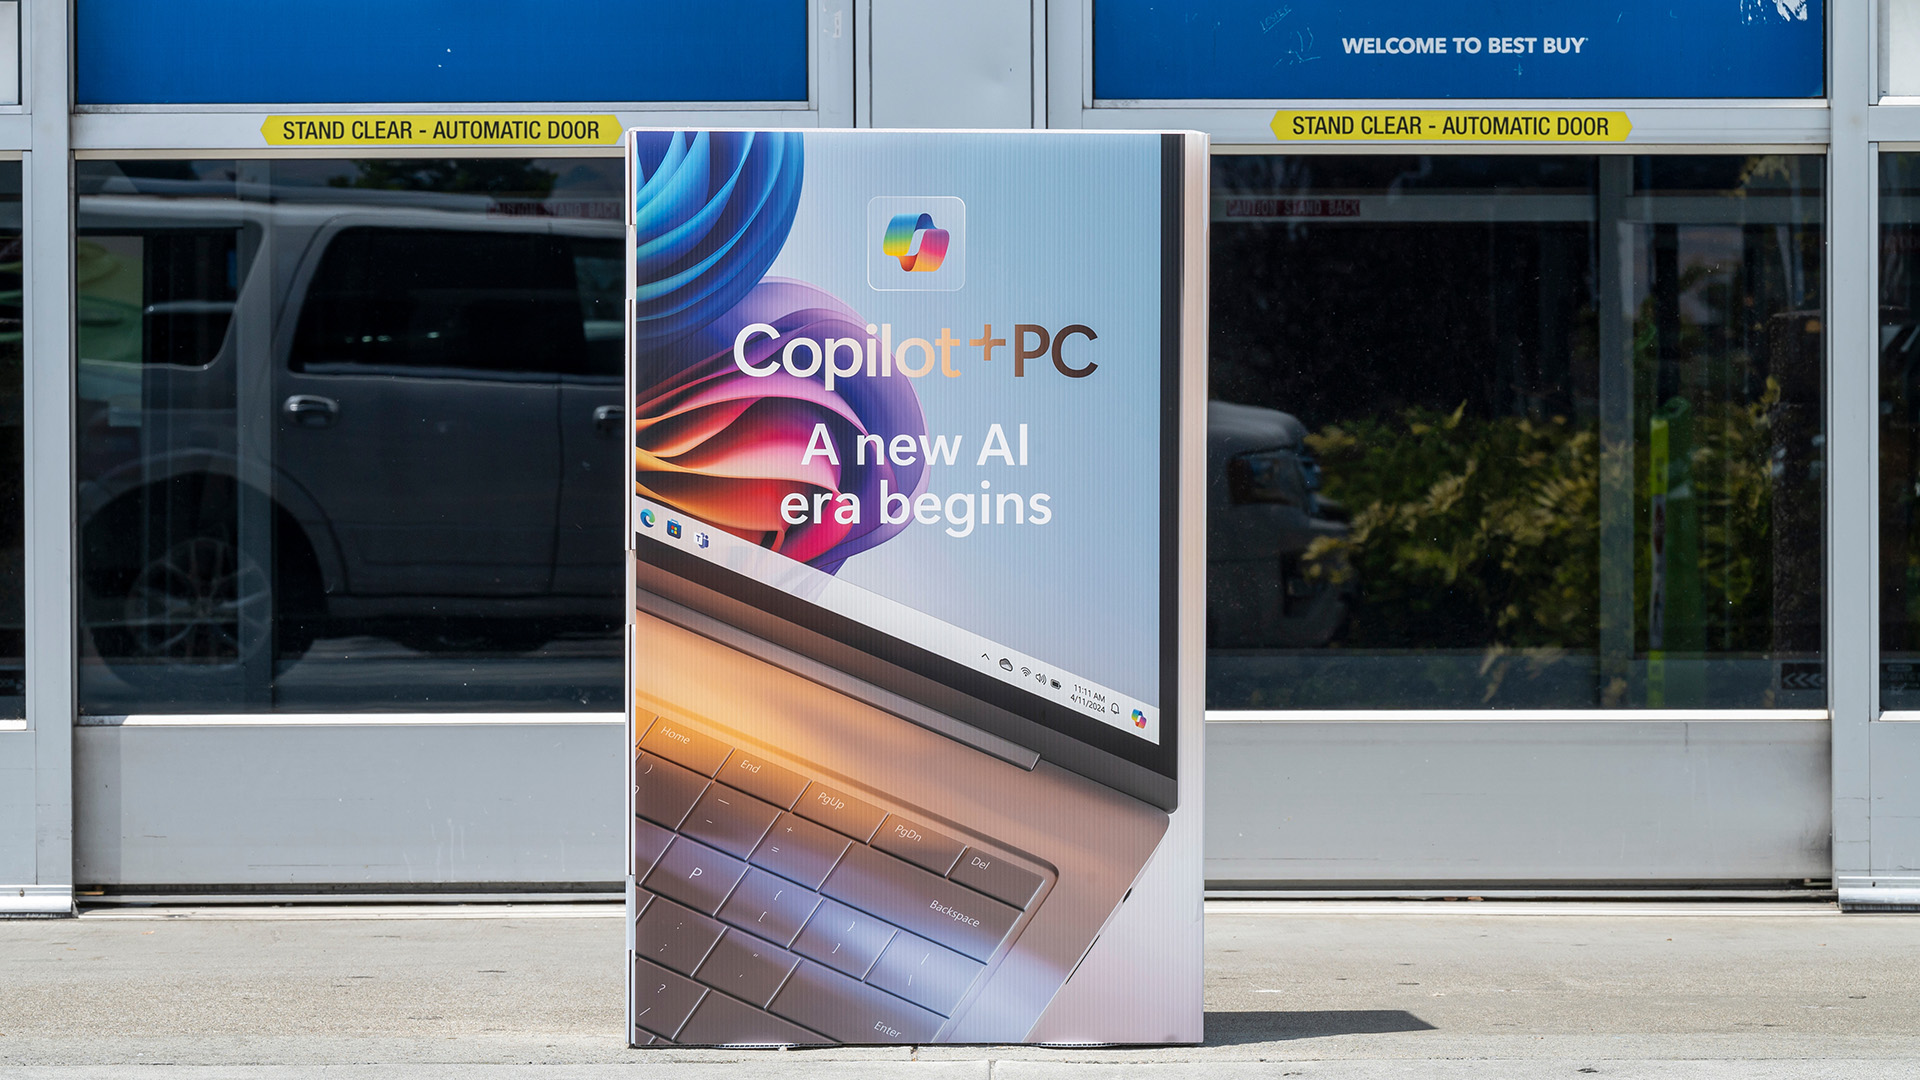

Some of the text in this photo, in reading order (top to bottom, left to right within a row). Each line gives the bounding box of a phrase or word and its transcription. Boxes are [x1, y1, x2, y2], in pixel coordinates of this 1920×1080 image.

[1342, 37, 1585, 54] WELCOME TO BEST BUY
[283, 121, 345, 140] STAND
[351, 121, 412, 140] CLEAR
[433, 120, 541, 140] AUTOMATIC
[548, 120, 600, 140] DOOR
[1293, 116, 1354, 135] STAND
[1361, 116, 1422, 135] CLEAR
[1442, 116, 1550, 135] AUTOMATIC
[1557, 117, 1609, 136] DOOR
[1227, 200, 1360, 215] CAUTION STAND BACK
[801, 423, 1028, 467] A new AI
[780, 479, 1052, 538] era begins
[1074, 684, 1105, 703] 11:11 AM
[1070, 694, 1105, 713] 4/11/2024
[660, 726, 691, 745] Home
[740, 759, 762, 774] End
[817, 791, 845, 810] PgUp
[894, 824, 923, 842] PgDn
[688, 867, 703, 879] P
[970, 856, 991, 871] Del
[929, 899, 981, 928] Backspace
[873, 1020, 902, 1038] Enter
